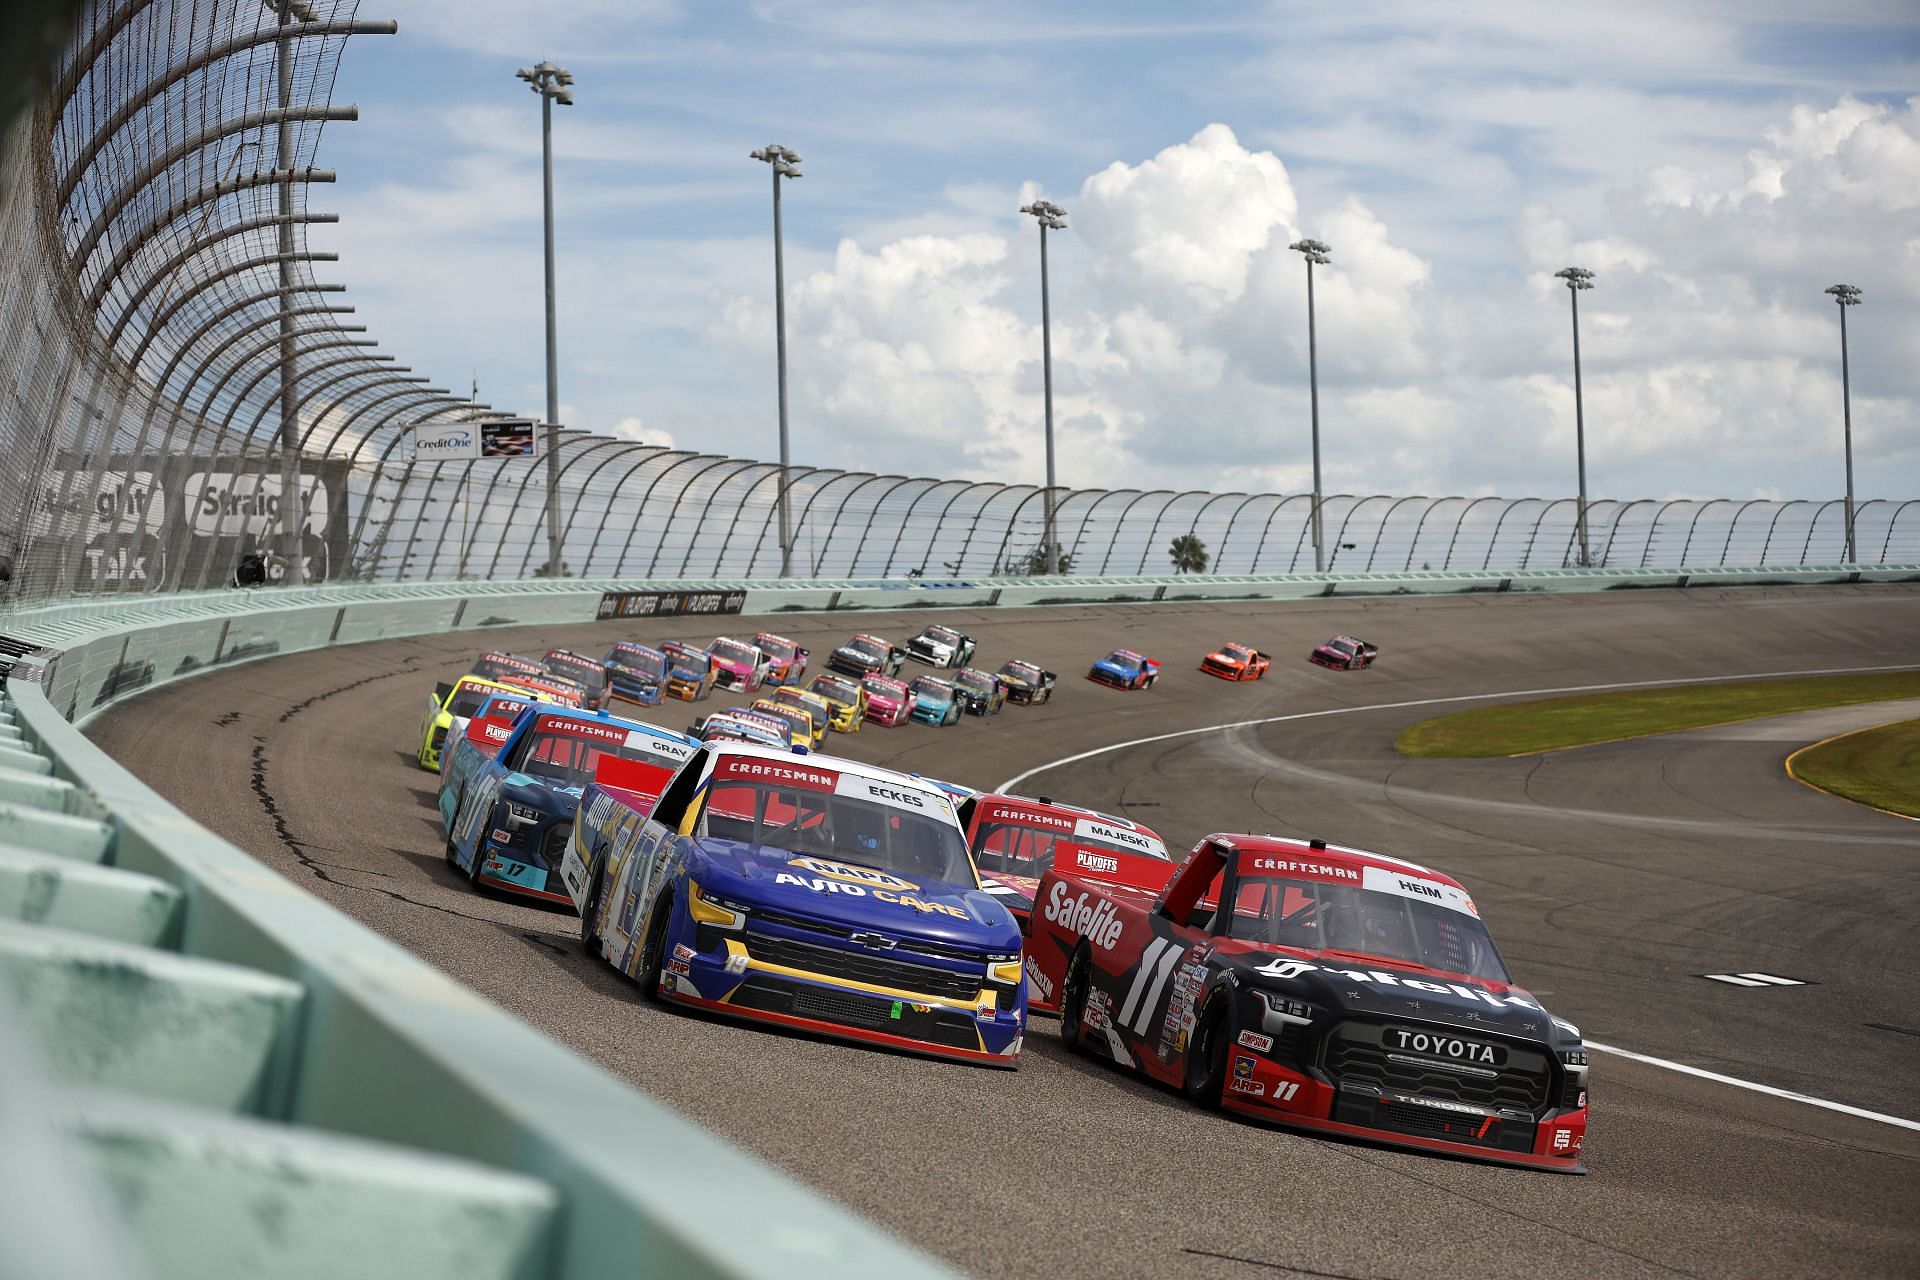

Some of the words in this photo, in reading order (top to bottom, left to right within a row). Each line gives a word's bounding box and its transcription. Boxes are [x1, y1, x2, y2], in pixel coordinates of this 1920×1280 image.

[202, 486, 312, 525] Straigt
[86, 548, 147, 580] Talk
[547, 720, 622, 741] CRAFTSMAN
[652, 742, 687, 758] GRAY
[729, 763, 832, 786] CRAFTSMAN
[868, 785, 924, 808] ECKES
[993, 809, 1072, 829] CRAFTSMAN
[1091, 825, 1149, 849] MAJESKI
[507, 863, 526, 877] 17
[810, 861, 901, 887] NAPA
[1077, 853, 1118, 872] PLAYOFFS
[1254, 858, 1358, 880] CRAFTSMAN
[1398, 880, 1442, 899] HEIM
[775, 873, 867, 897] AUTO
[873, 890, 970, 921] CARE
[1044, 881, 1123, 950] Safelite
[724, 955, 749, 975] 19
[1026, 955, 1053, 997] SiriusXM
[1117, 936, 1185, 1038] 11
[1240, 1032, 1270, 1049] SIMPSON
[1397, 1030, 1496, 1064] TOYOTA
[1272, 1080, 1300, 1102] 11
[1394, 1094, 1485, 1115] TUNDRA
